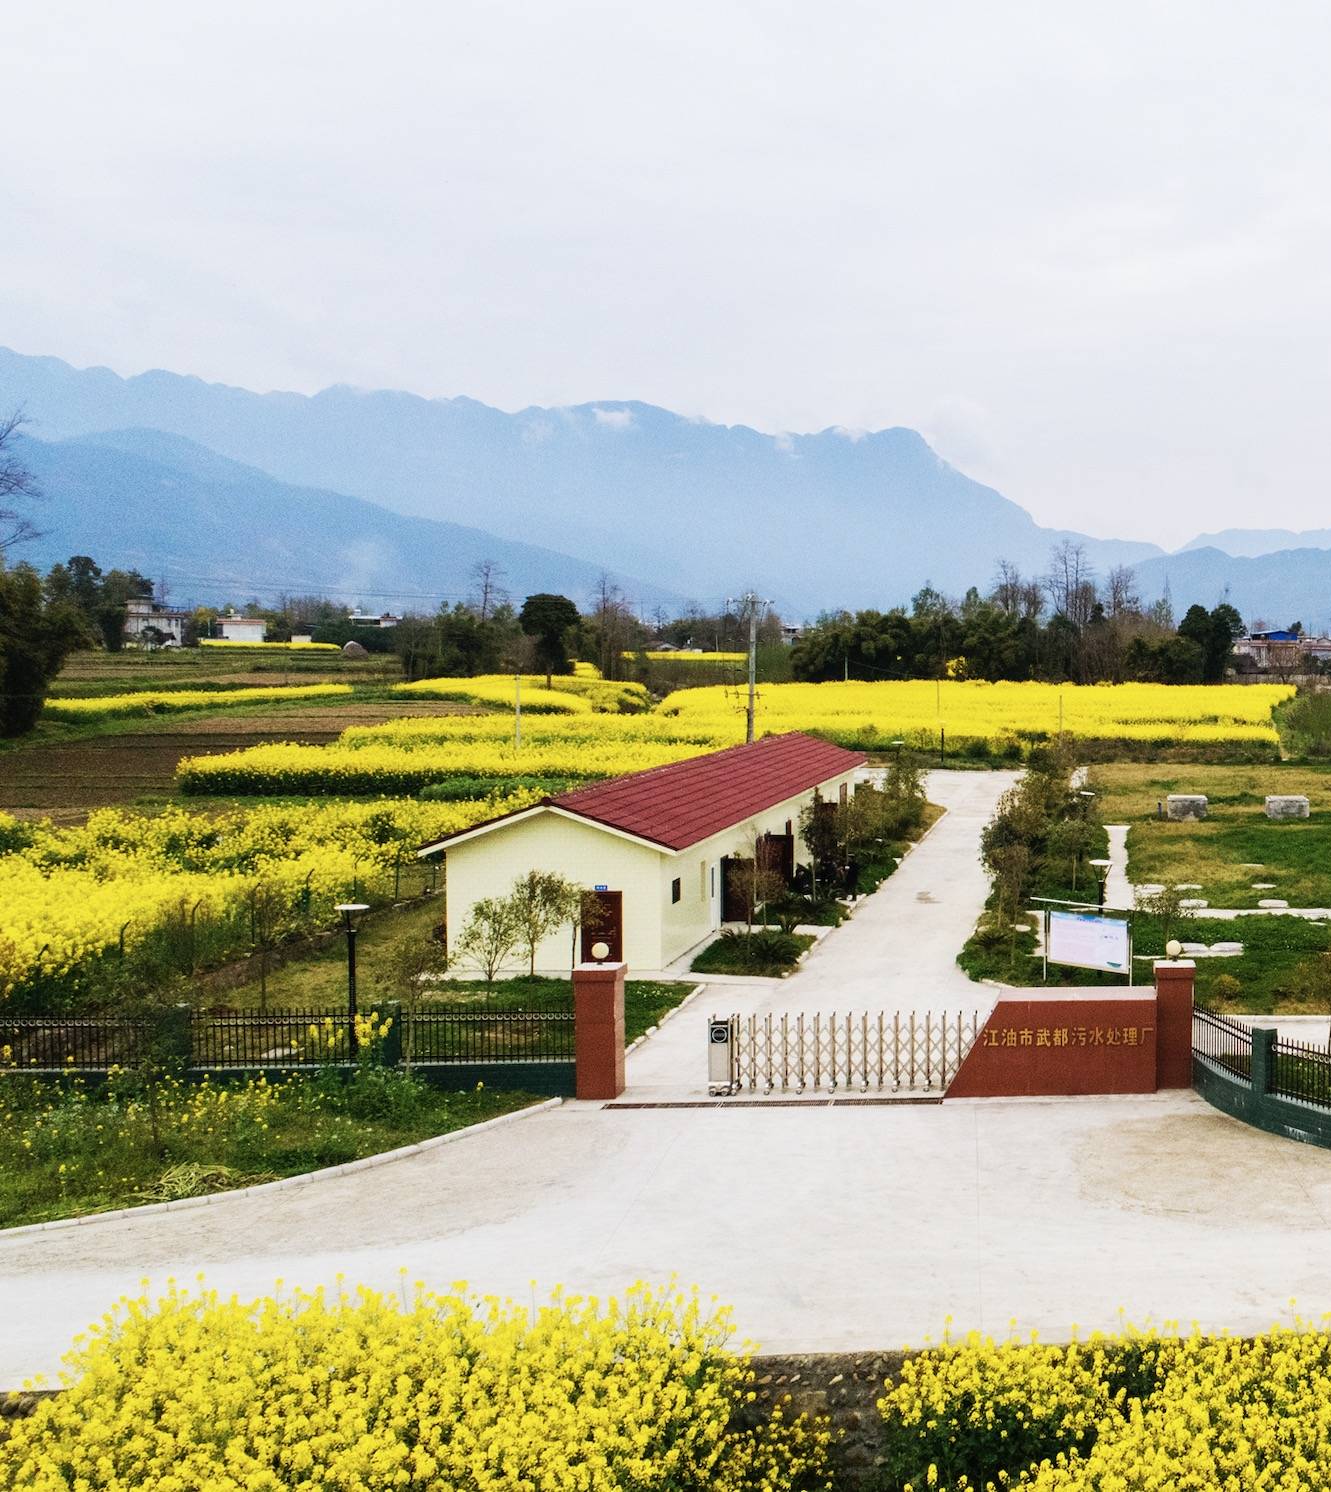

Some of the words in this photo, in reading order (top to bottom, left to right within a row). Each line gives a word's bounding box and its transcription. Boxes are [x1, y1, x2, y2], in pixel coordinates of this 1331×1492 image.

[983, 1027, 1154, 1046] 江油市武都污水处理厂
